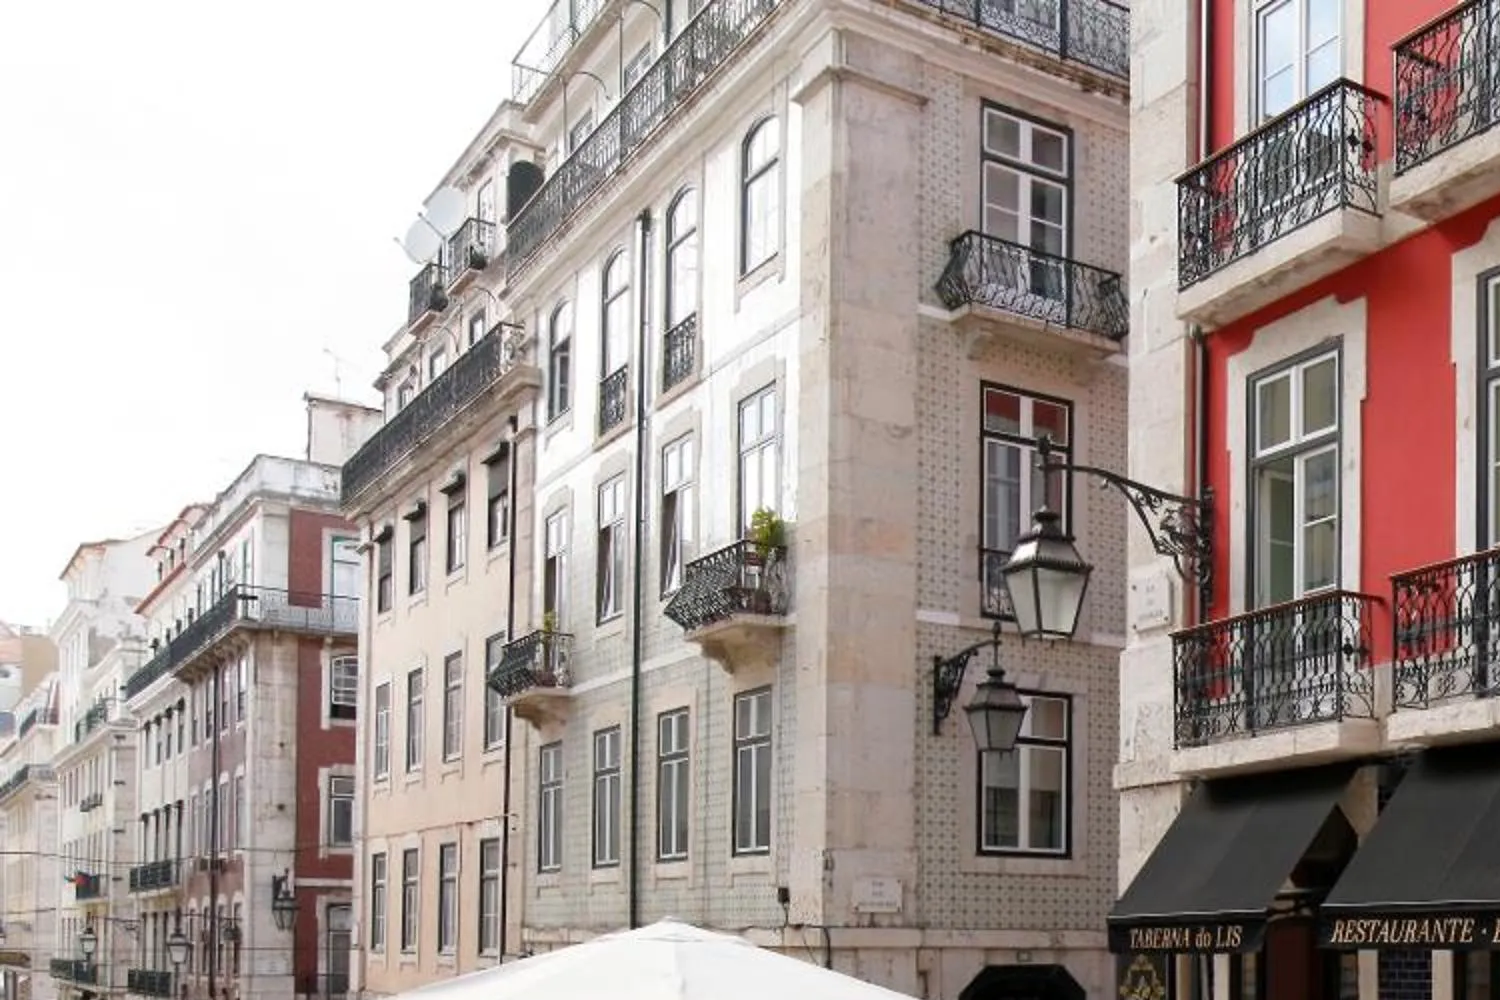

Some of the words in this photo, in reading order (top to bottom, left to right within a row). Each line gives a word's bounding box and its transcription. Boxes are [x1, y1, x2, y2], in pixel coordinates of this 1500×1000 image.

[1129, 927, 1190, 949] TABERNA
[1195, 926, 1212, 948] do
[1216, 925, 1242, 948] LIS
[1330, 917, 1475, 944] RESTAURANTE
